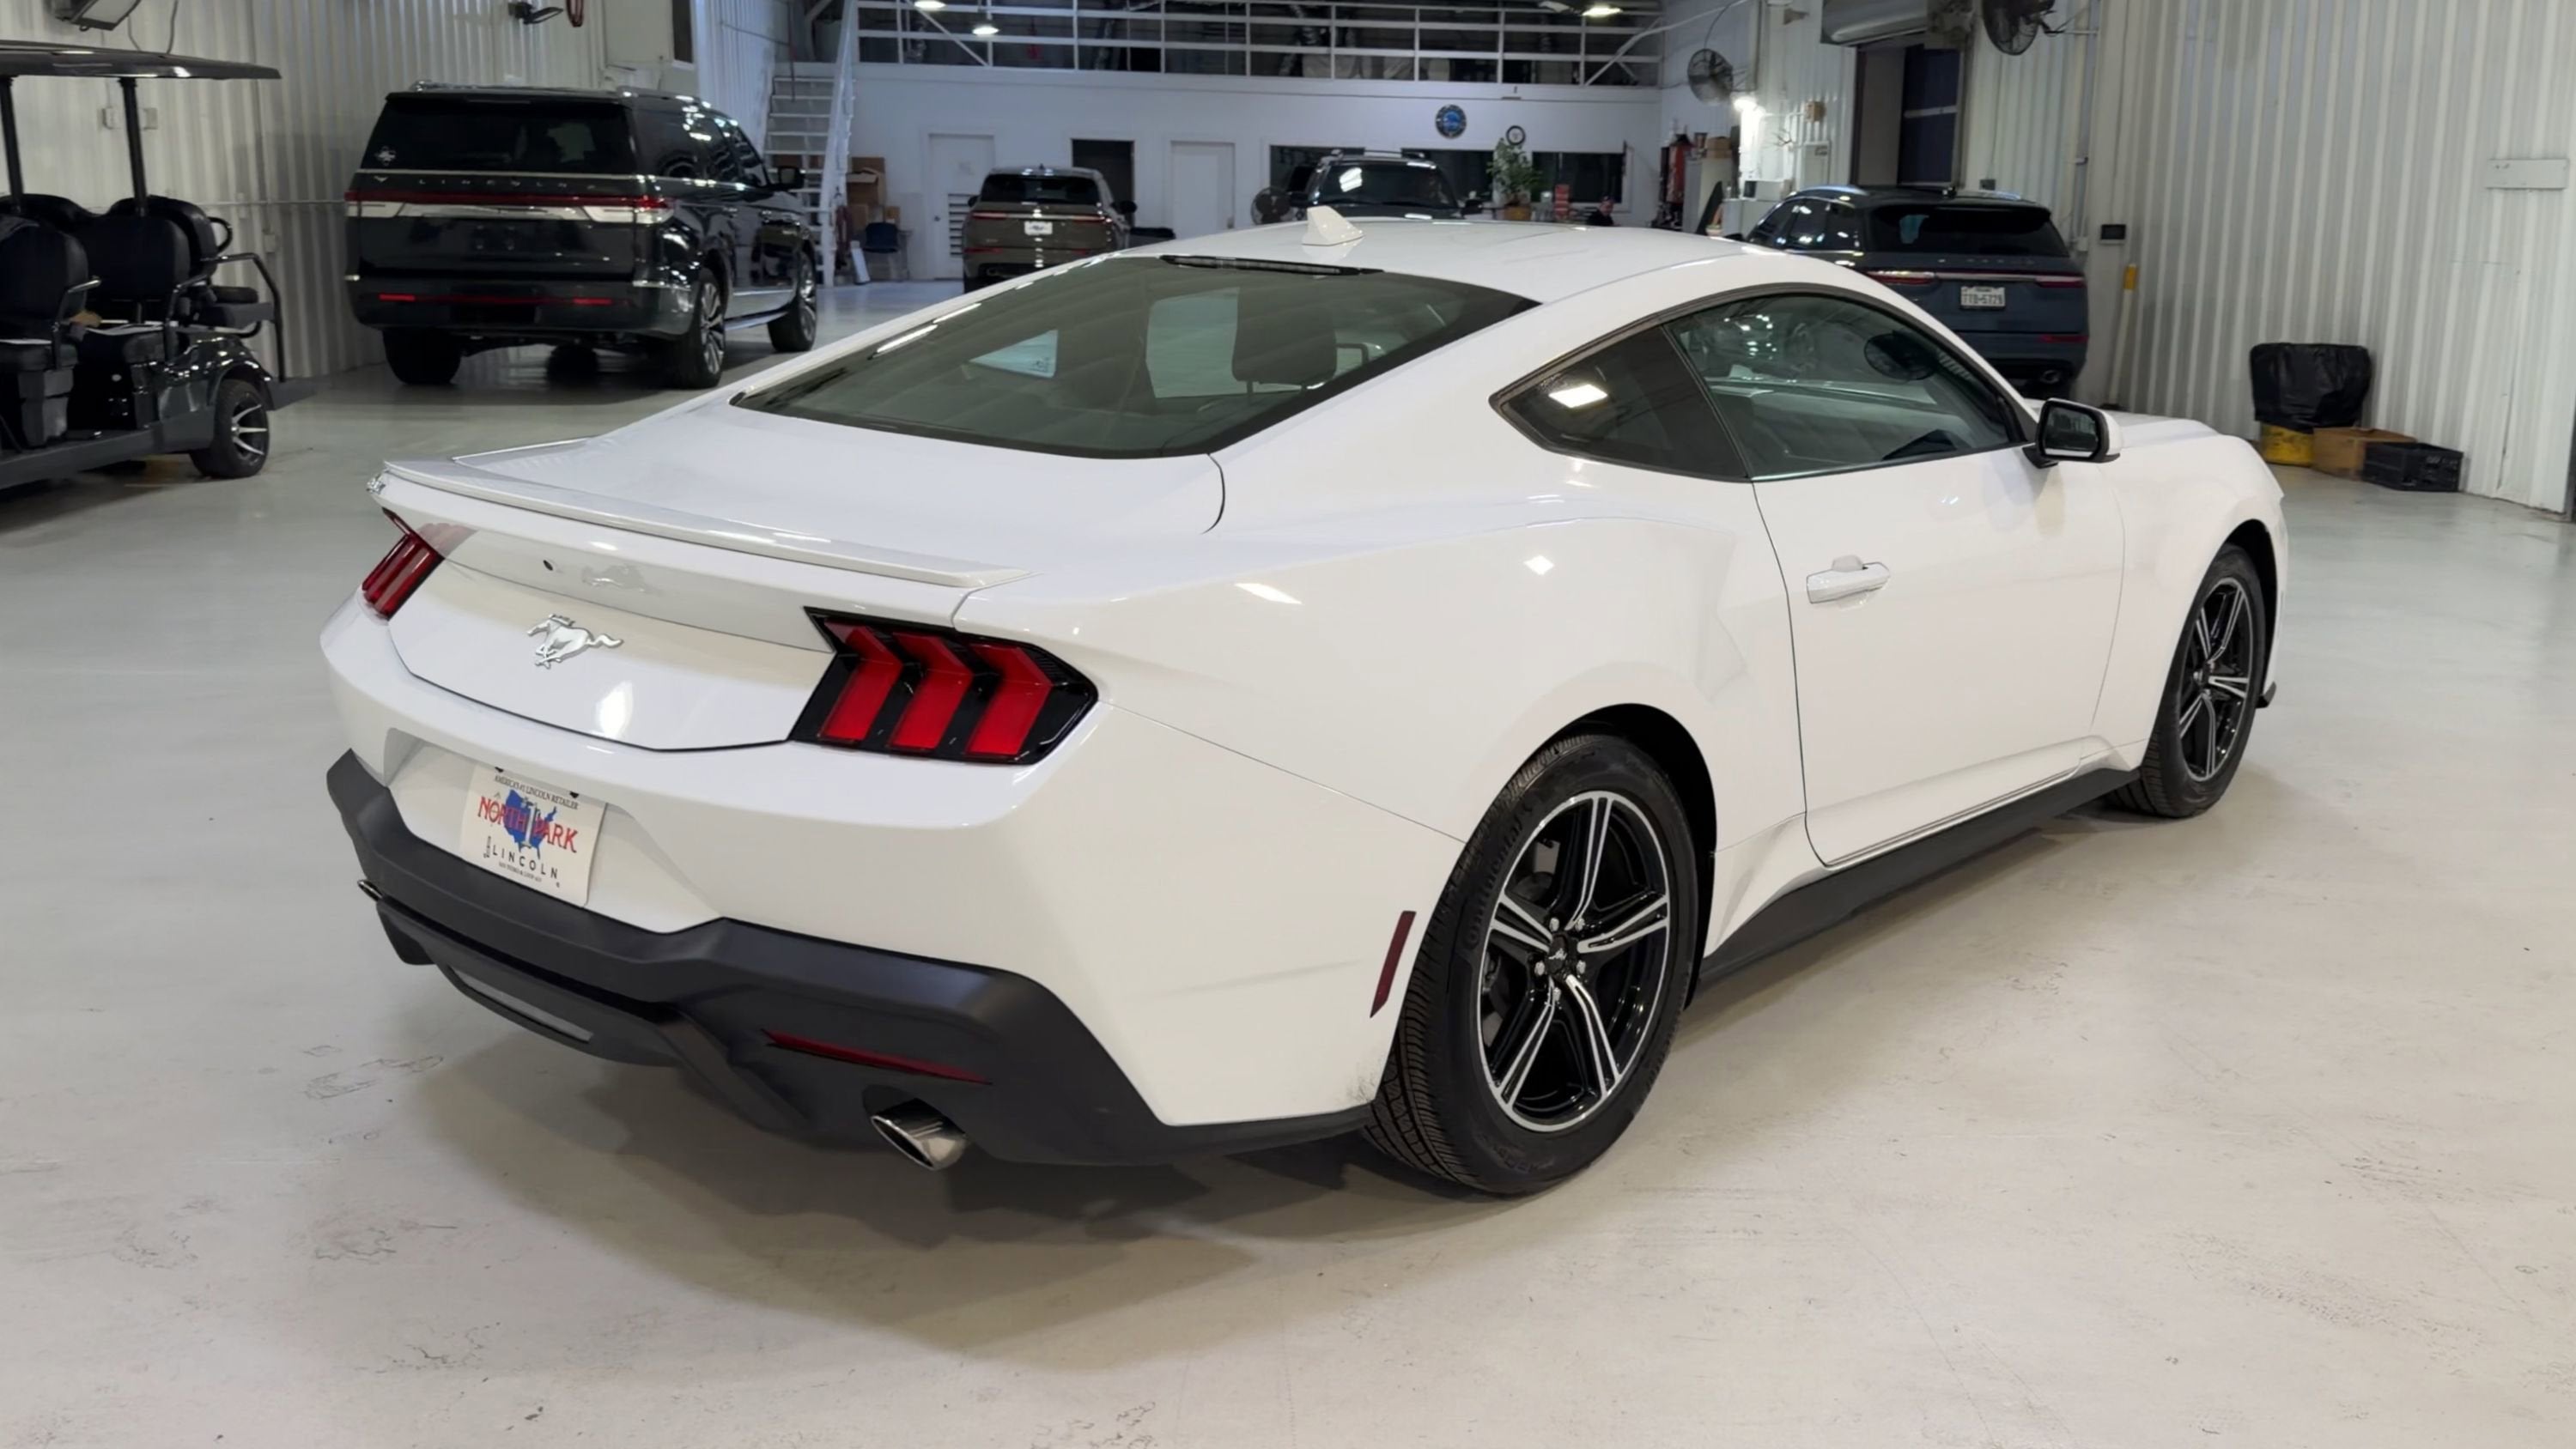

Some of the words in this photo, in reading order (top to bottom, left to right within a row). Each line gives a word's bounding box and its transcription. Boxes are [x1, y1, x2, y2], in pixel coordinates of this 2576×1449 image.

[526, 785, 550, 801] LINCOLN
[551, 795, 579, 809] RETAILER
[477, 796, 527, 833] NORTH
[532, 814, 578, 853] PARK
[493, 845, 558, 878] LINCOLN
